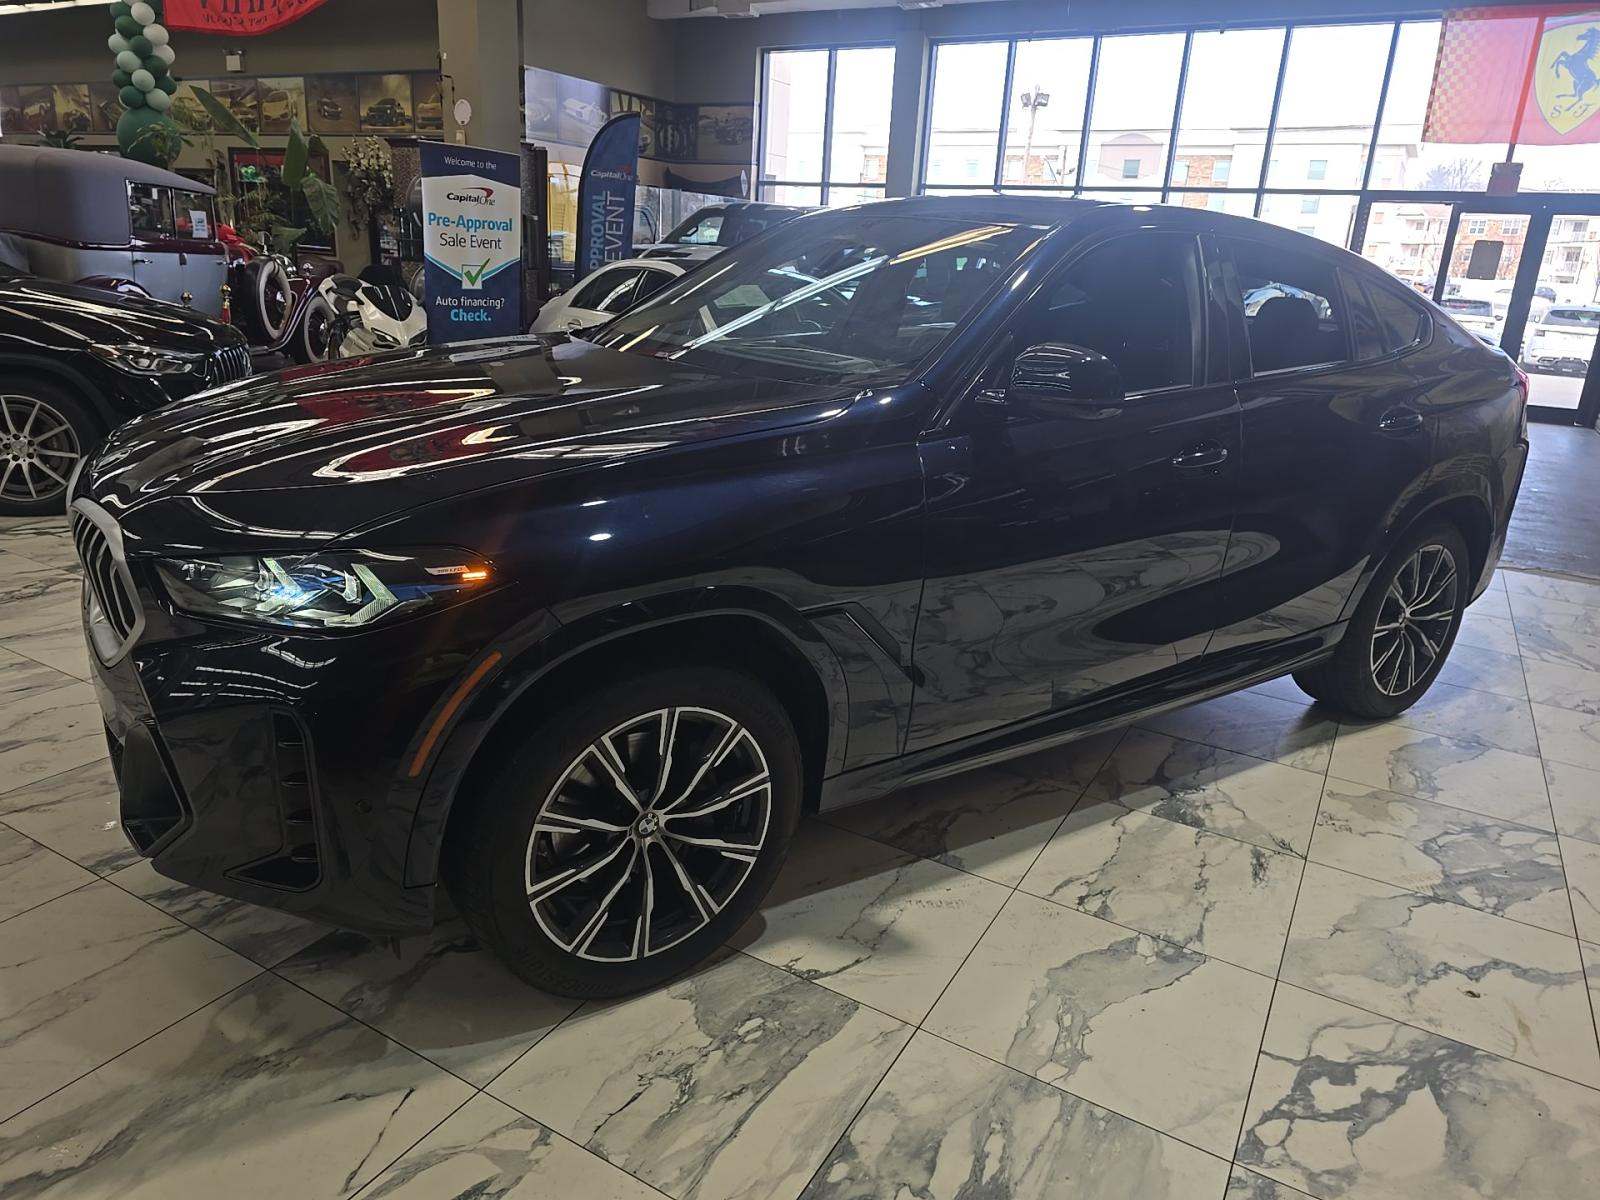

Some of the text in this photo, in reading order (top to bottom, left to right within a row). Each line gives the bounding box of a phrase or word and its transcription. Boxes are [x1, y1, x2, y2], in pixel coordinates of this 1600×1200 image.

[444, 156, 497, 170] Welcome to the
[428, 212, 513, 232] Pre-Approval
[589, 190, 606, 270] PPROVAL
[604, 191, 625, 262] EVENT
[440, 233, 502, 249] Sale Event
[435, 296, 505, 310] Auto financing?
[450, 308, 492, 322] Check.
